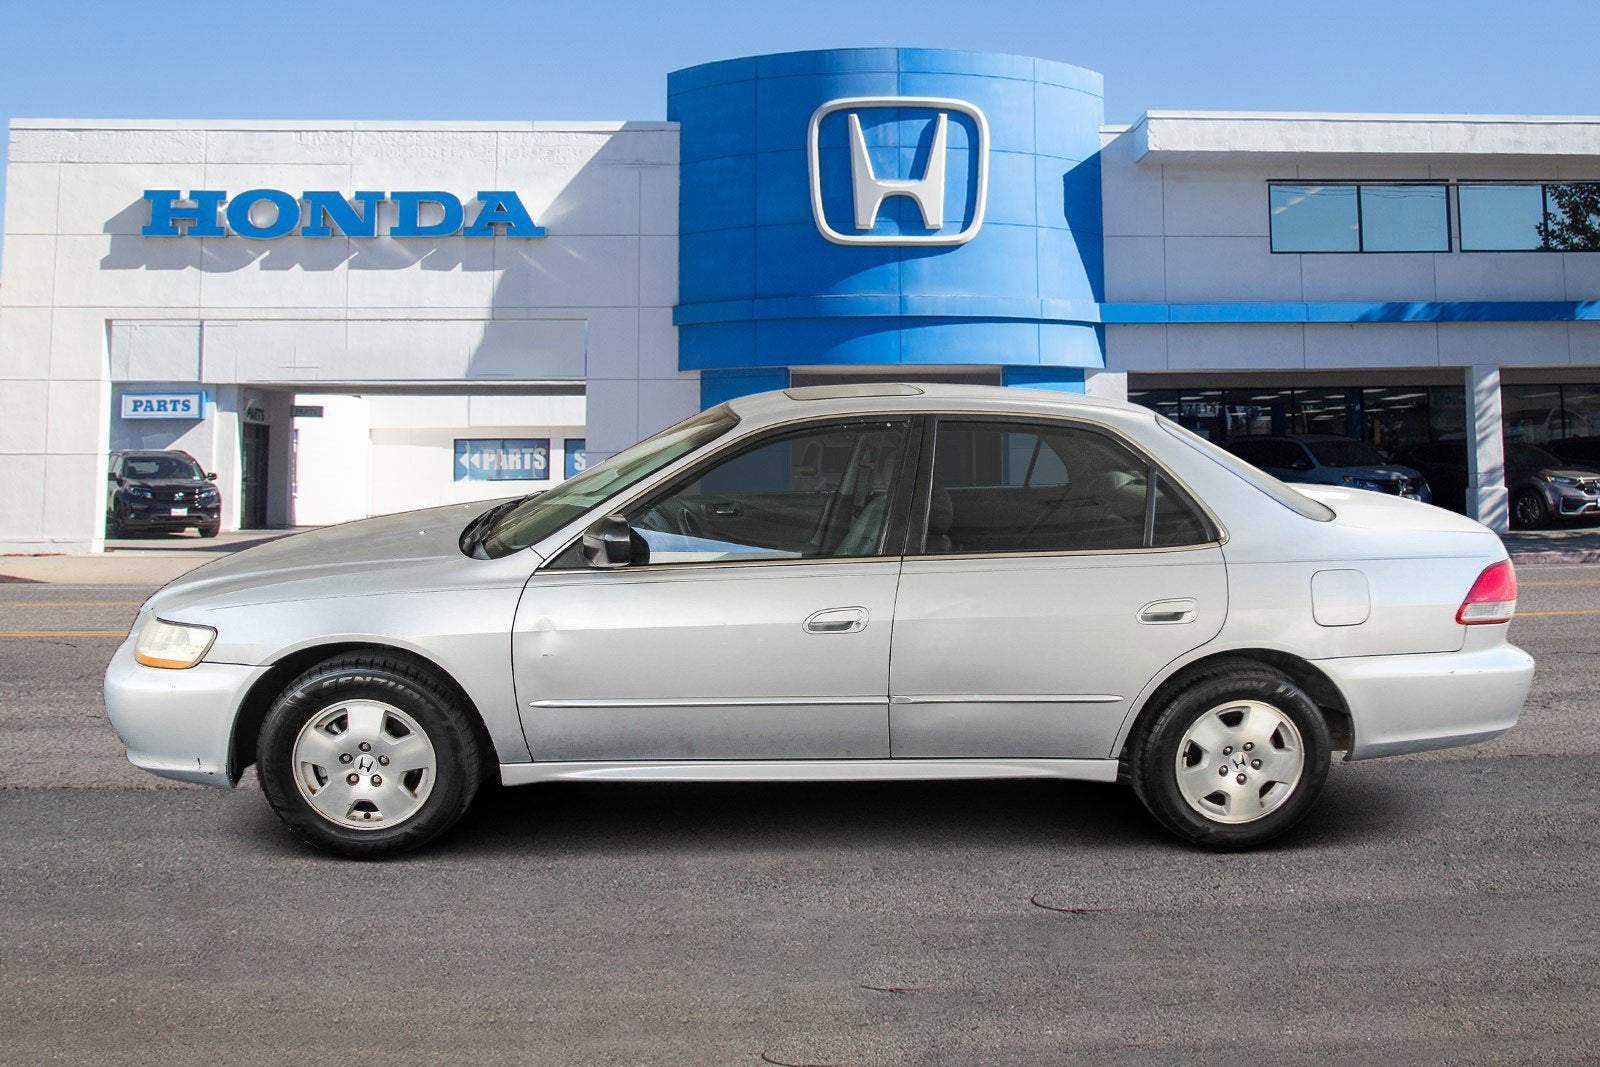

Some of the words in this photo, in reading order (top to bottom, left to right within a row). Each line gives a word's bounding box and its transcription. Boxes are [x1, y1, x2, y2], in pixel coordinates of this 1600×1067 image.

[141, 188, 547, 240] HONDA
[132, 399, 192, 413] PARTS
[482, 447, 547, 471] PARTS
